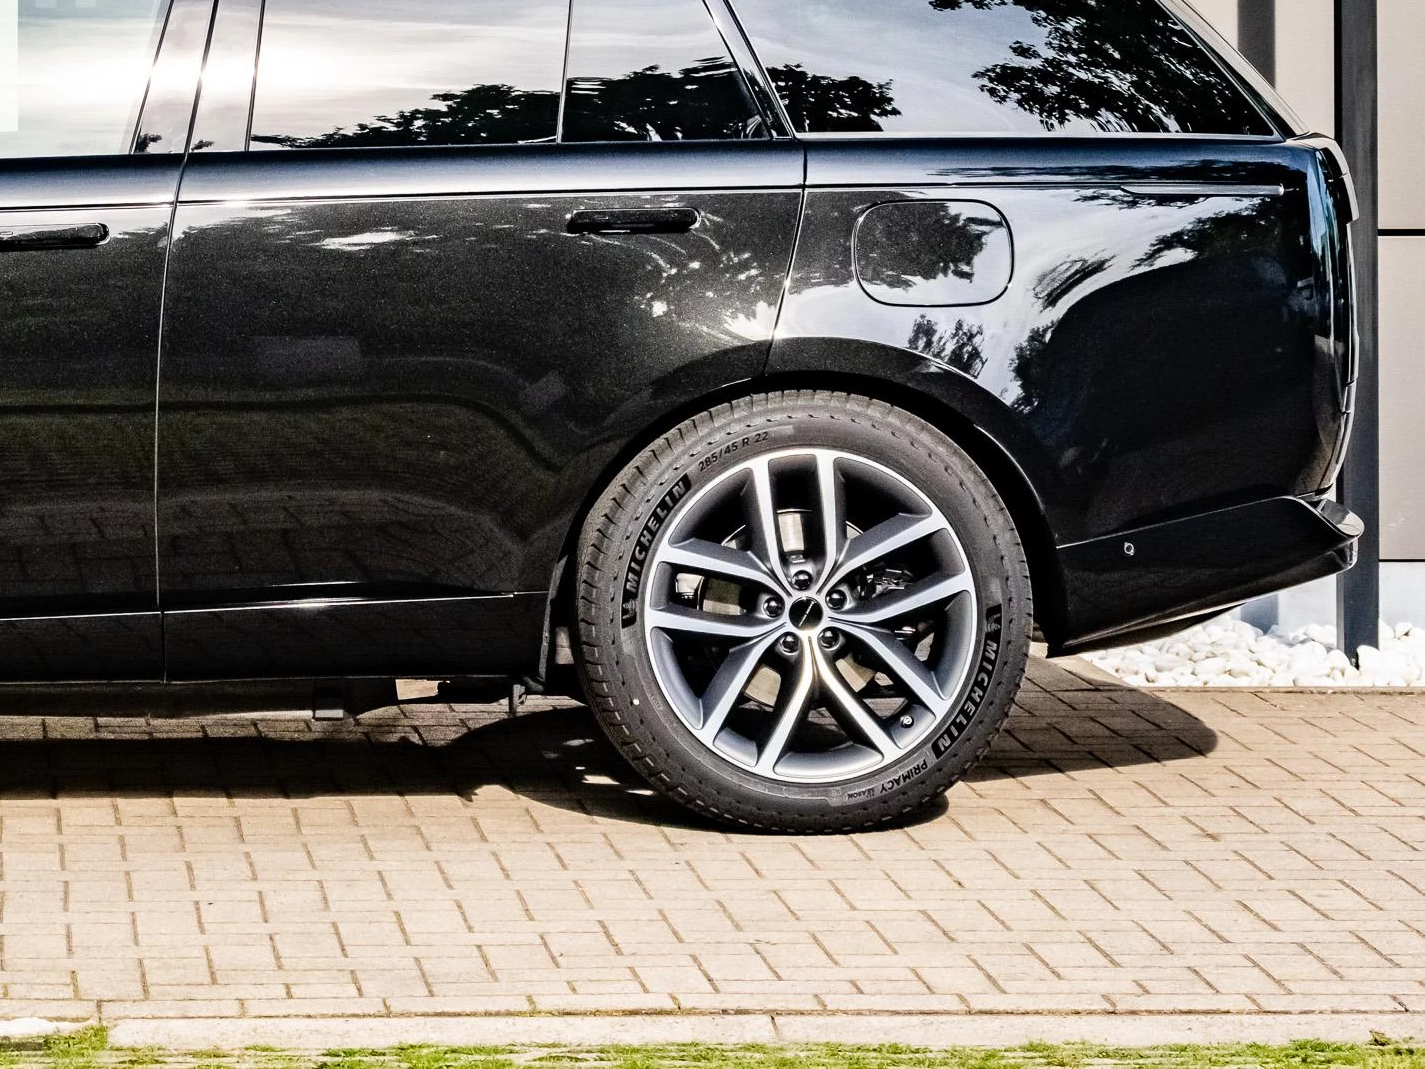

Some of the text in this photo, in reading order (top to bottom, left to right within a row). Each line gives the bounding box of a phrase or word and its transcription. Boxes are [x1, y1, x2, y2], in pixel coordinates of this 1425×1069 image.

[698, 431, 769, 472] 285/45 R 22
[625, 480, 686, 593] MICHELIN
[937, 639, 998, 752] MICHELIN
[879, 758, 928, 794] PRIMACY
